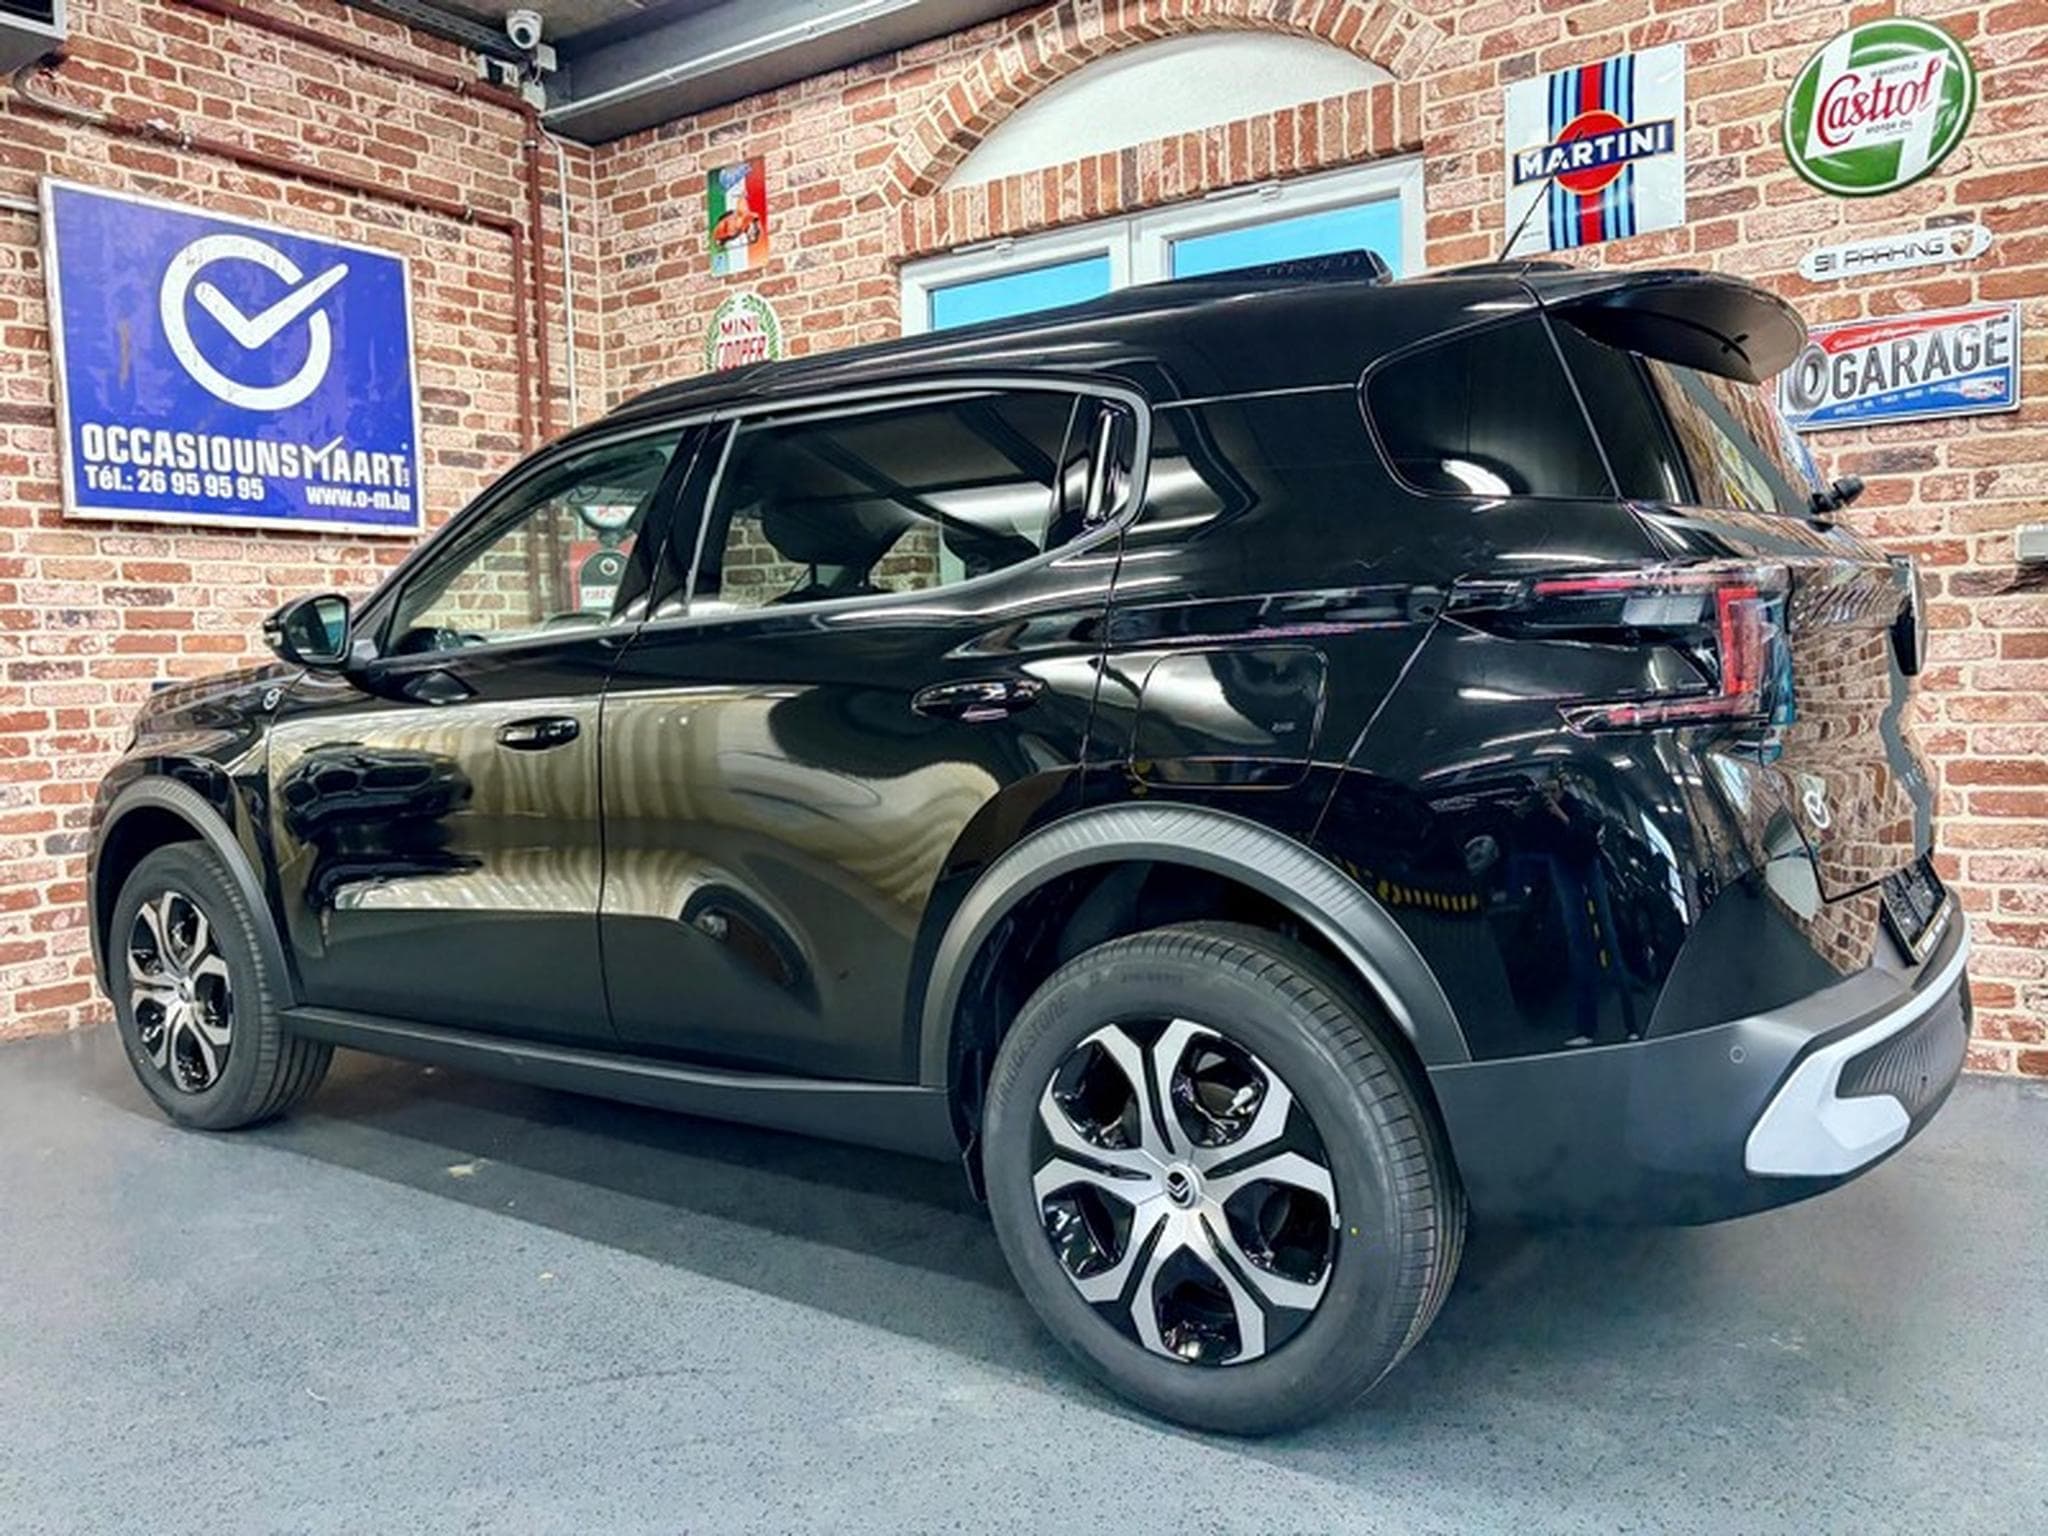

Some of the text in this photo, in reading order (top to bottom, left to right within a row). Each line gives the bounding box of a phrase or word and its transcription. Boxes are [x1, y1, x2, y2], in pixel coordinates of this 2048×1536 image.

[1817, 57, 1941, 148] Castrol
[1518, 124, 1667, 180] MARTINI
[1843, 237, 1944, 269] PARKING
[721, 315, 758, 334] MINI
[81, 422, 405, 487] OCCASIOUNSMAART
[136, 468, 167, 494] 26
[170, 471, 200, 496] 95
[204, 473, 233, 499] 95
[236, 476, 265, 501] 95
[305, 485, 410, 512] www.o-m.lu
